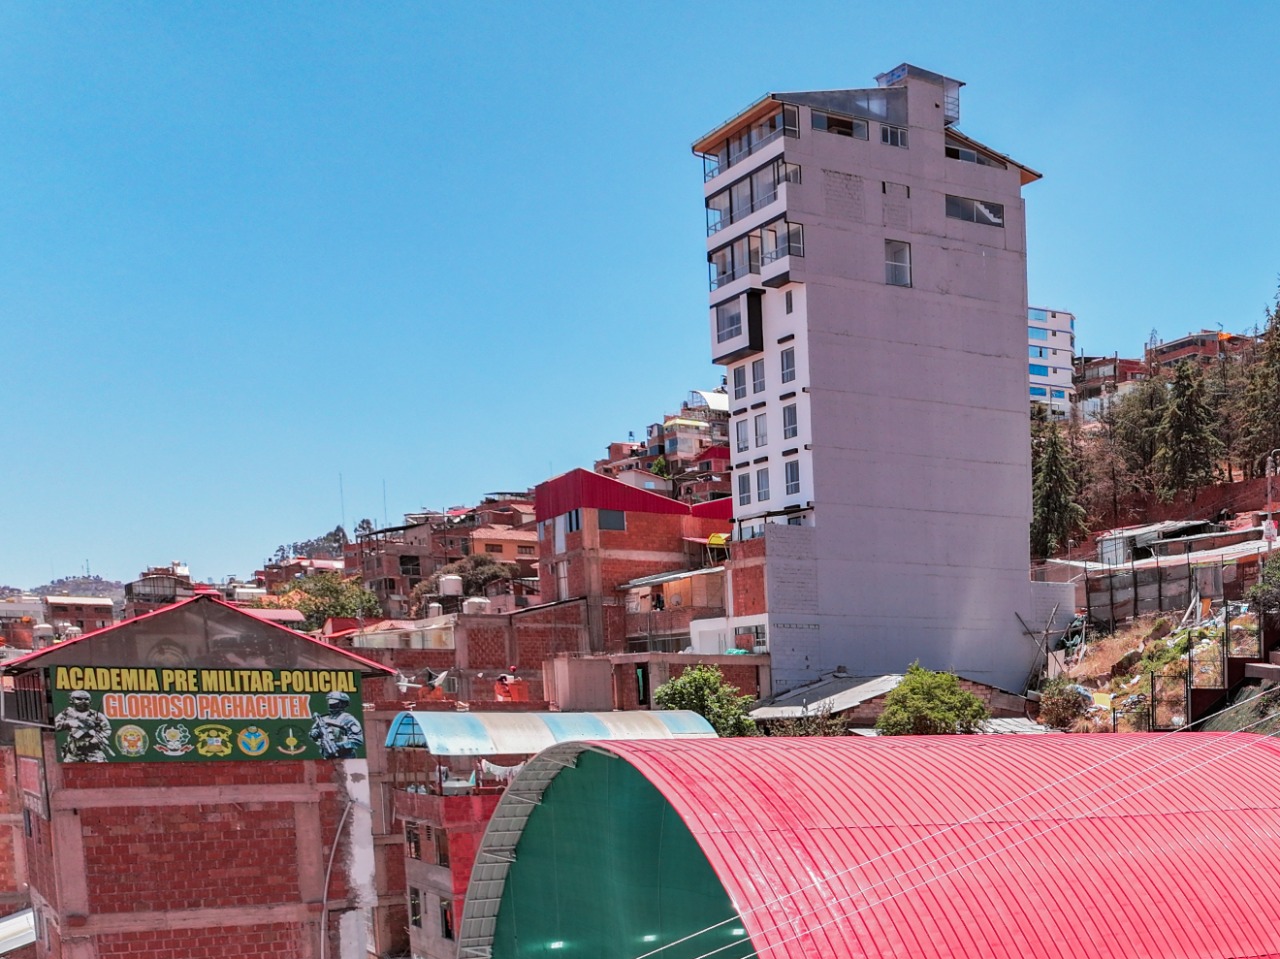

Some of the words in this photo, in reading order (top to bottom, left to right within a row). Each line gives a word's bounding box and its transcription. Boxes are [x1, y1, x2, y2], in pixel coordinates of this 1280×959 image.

[55, 667, 160, 691] ACADEMIA
[162, 669, 198, 692] PRE
[202, 669, 357, 693] MILITAR-POLICIAL
[102, 693, 196, 720] GLORIOSO
[198, 693, 312, 720] PACHACUTEK
